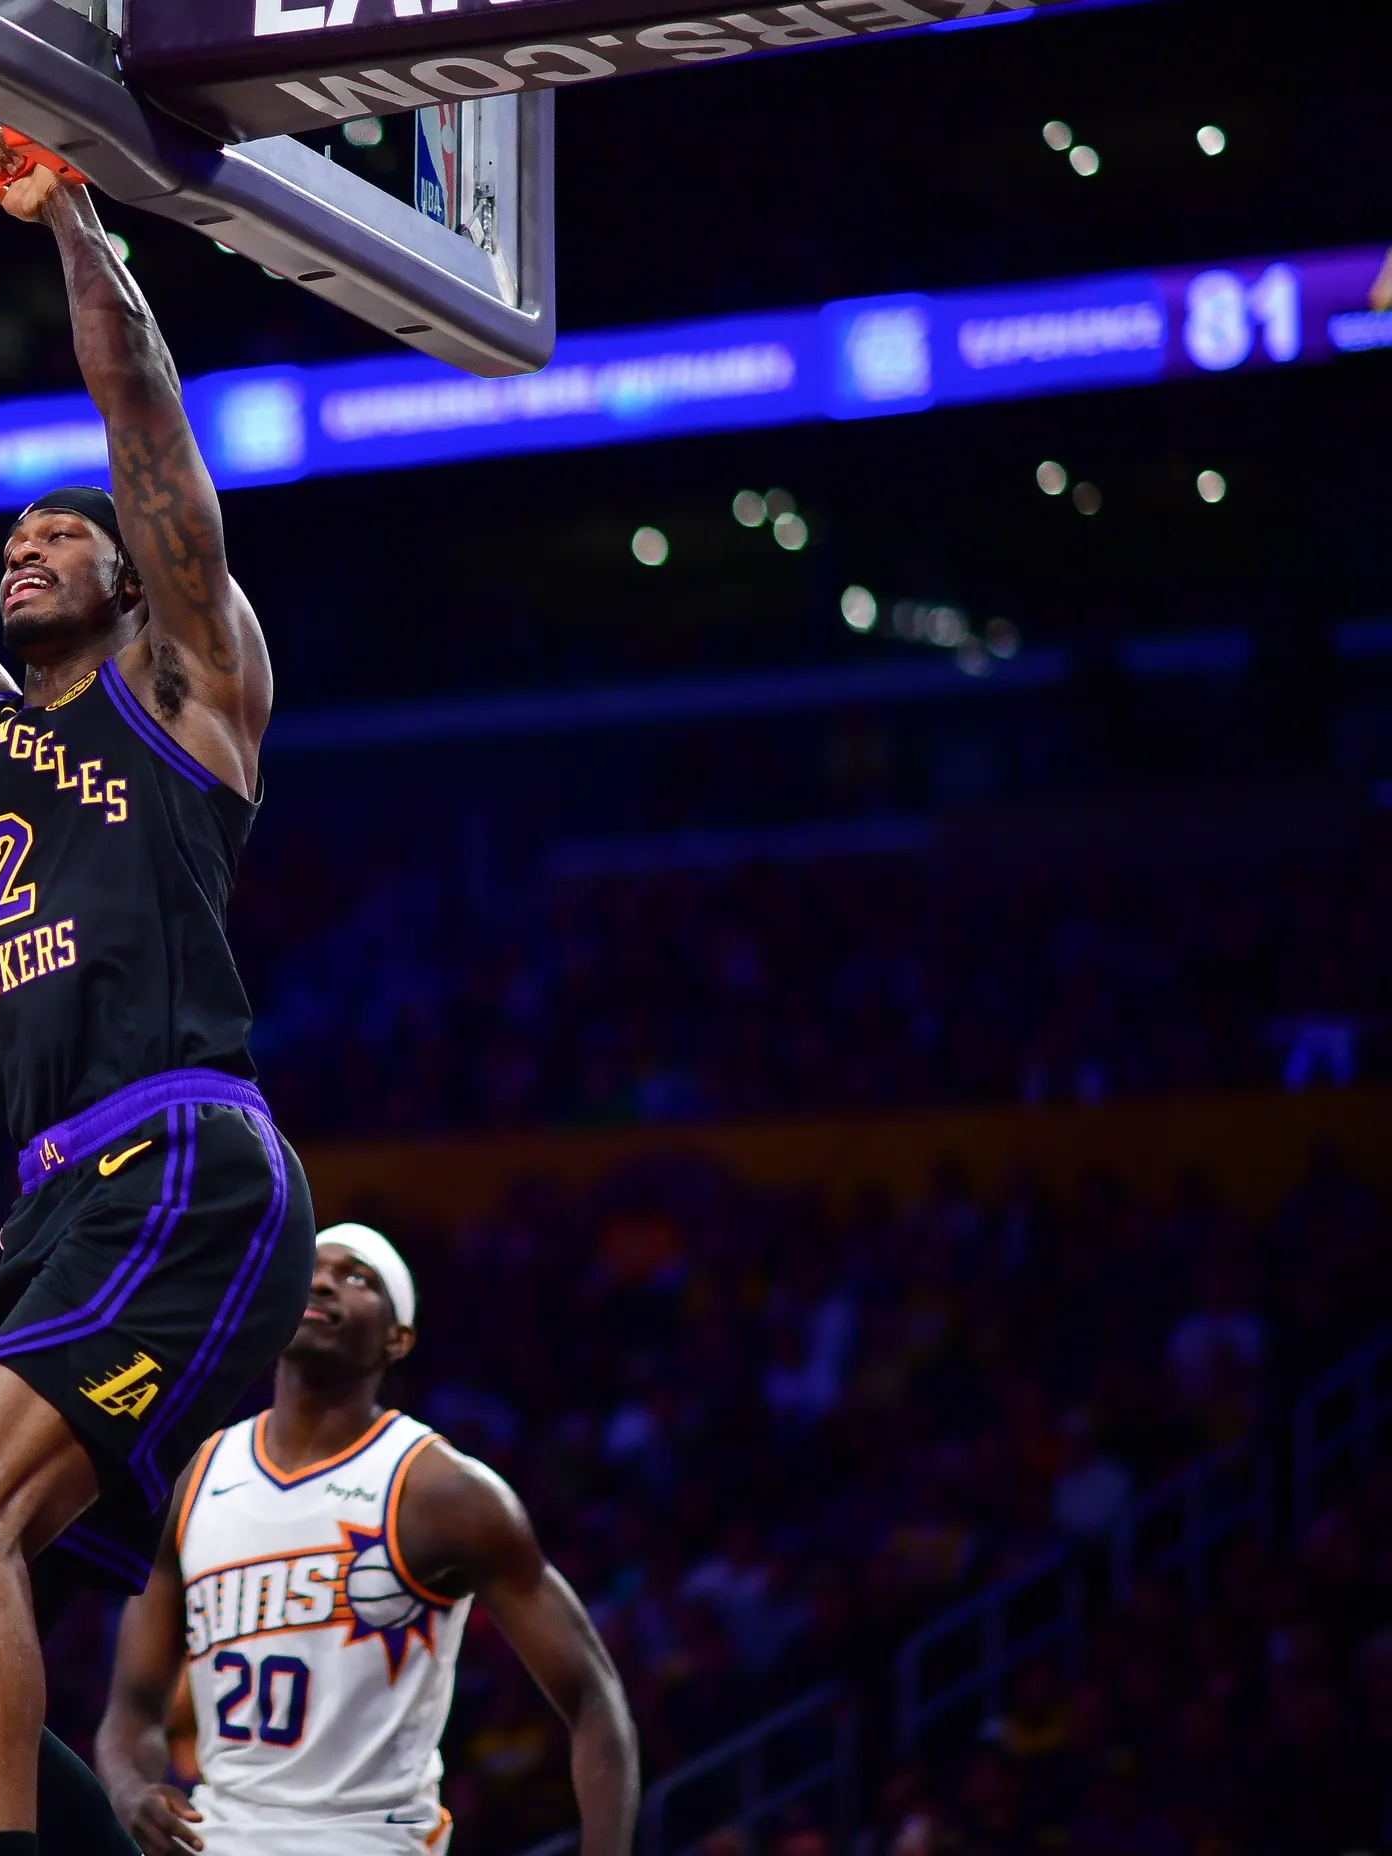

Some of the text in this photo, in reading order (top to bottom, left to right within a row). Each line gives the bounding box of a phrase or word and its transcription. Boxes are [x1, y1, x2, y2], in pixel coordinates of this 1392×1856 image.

[420, 177, 442, 217] NBA
[1183, 262, 1301, 371] 81
[39, 1137, 65, 1171] LAL
[213, 1650, 311, 1747] 20
